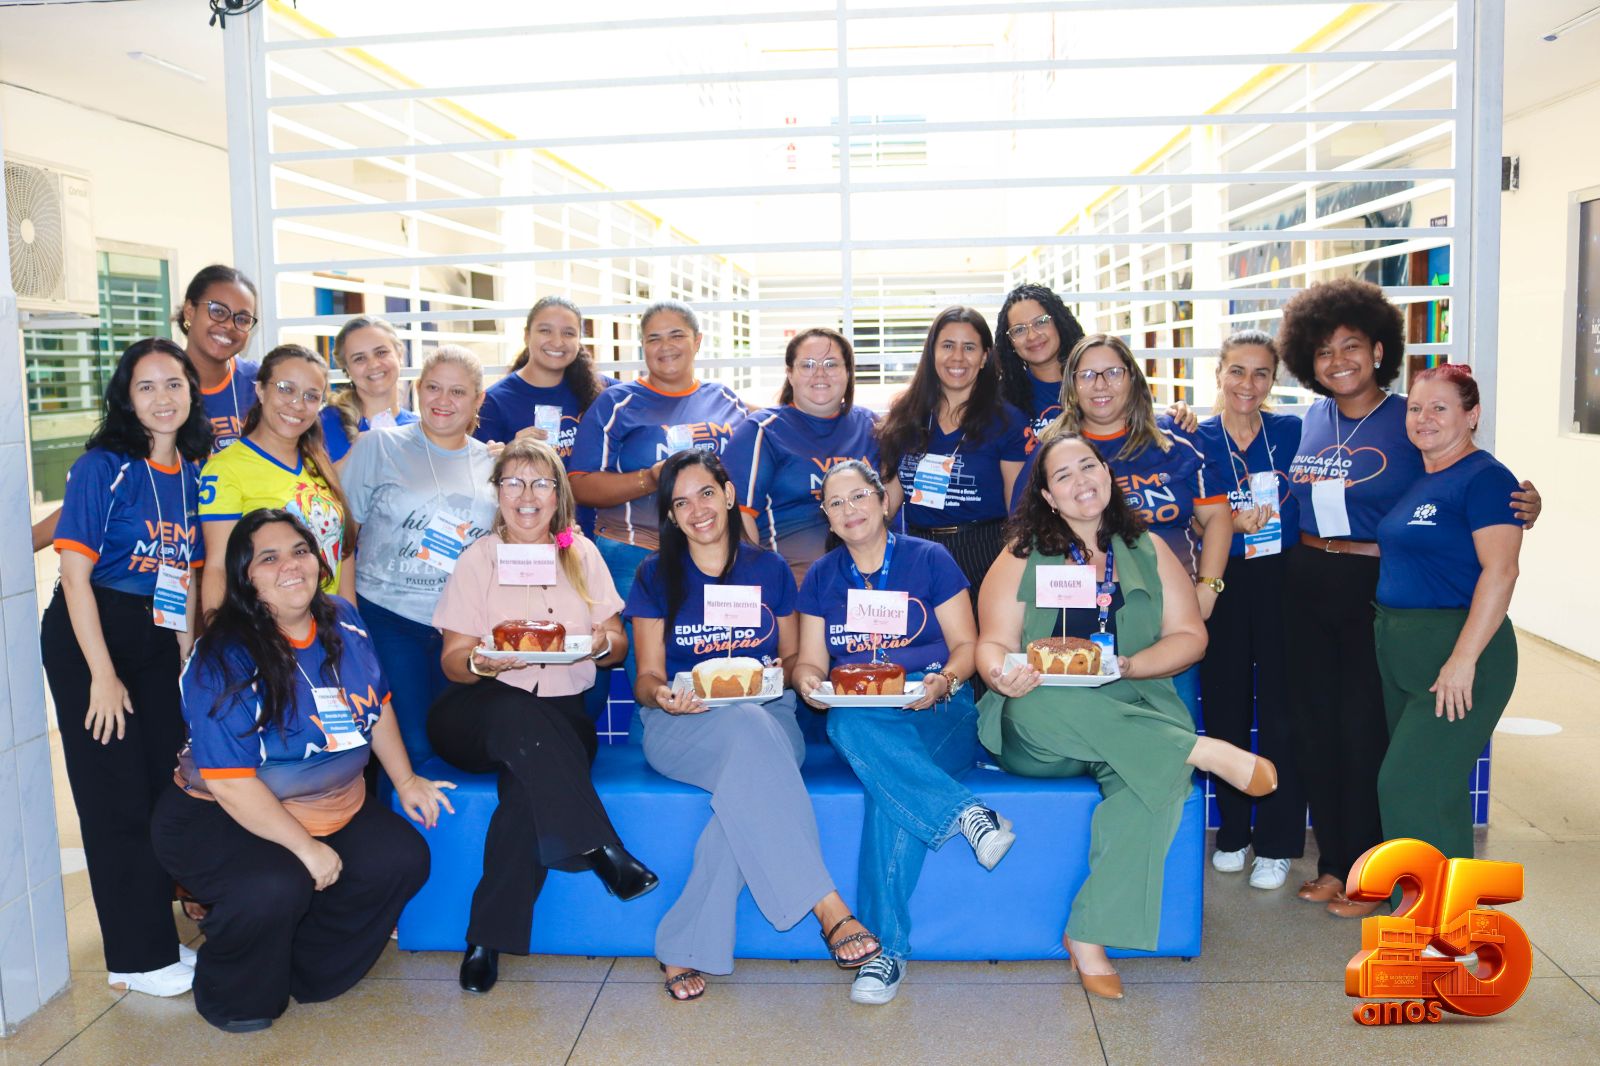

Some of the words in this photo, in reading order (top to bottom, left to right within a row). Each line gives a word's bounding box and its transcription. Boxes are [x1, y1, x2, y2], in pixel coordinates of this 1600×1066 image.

[1115, 473, 1162, 492] EM
[145, 520, 196, 544] VEM
[1050, 580, 1082, 588] CORAGEM
[734, 629, 756, 639] DO
